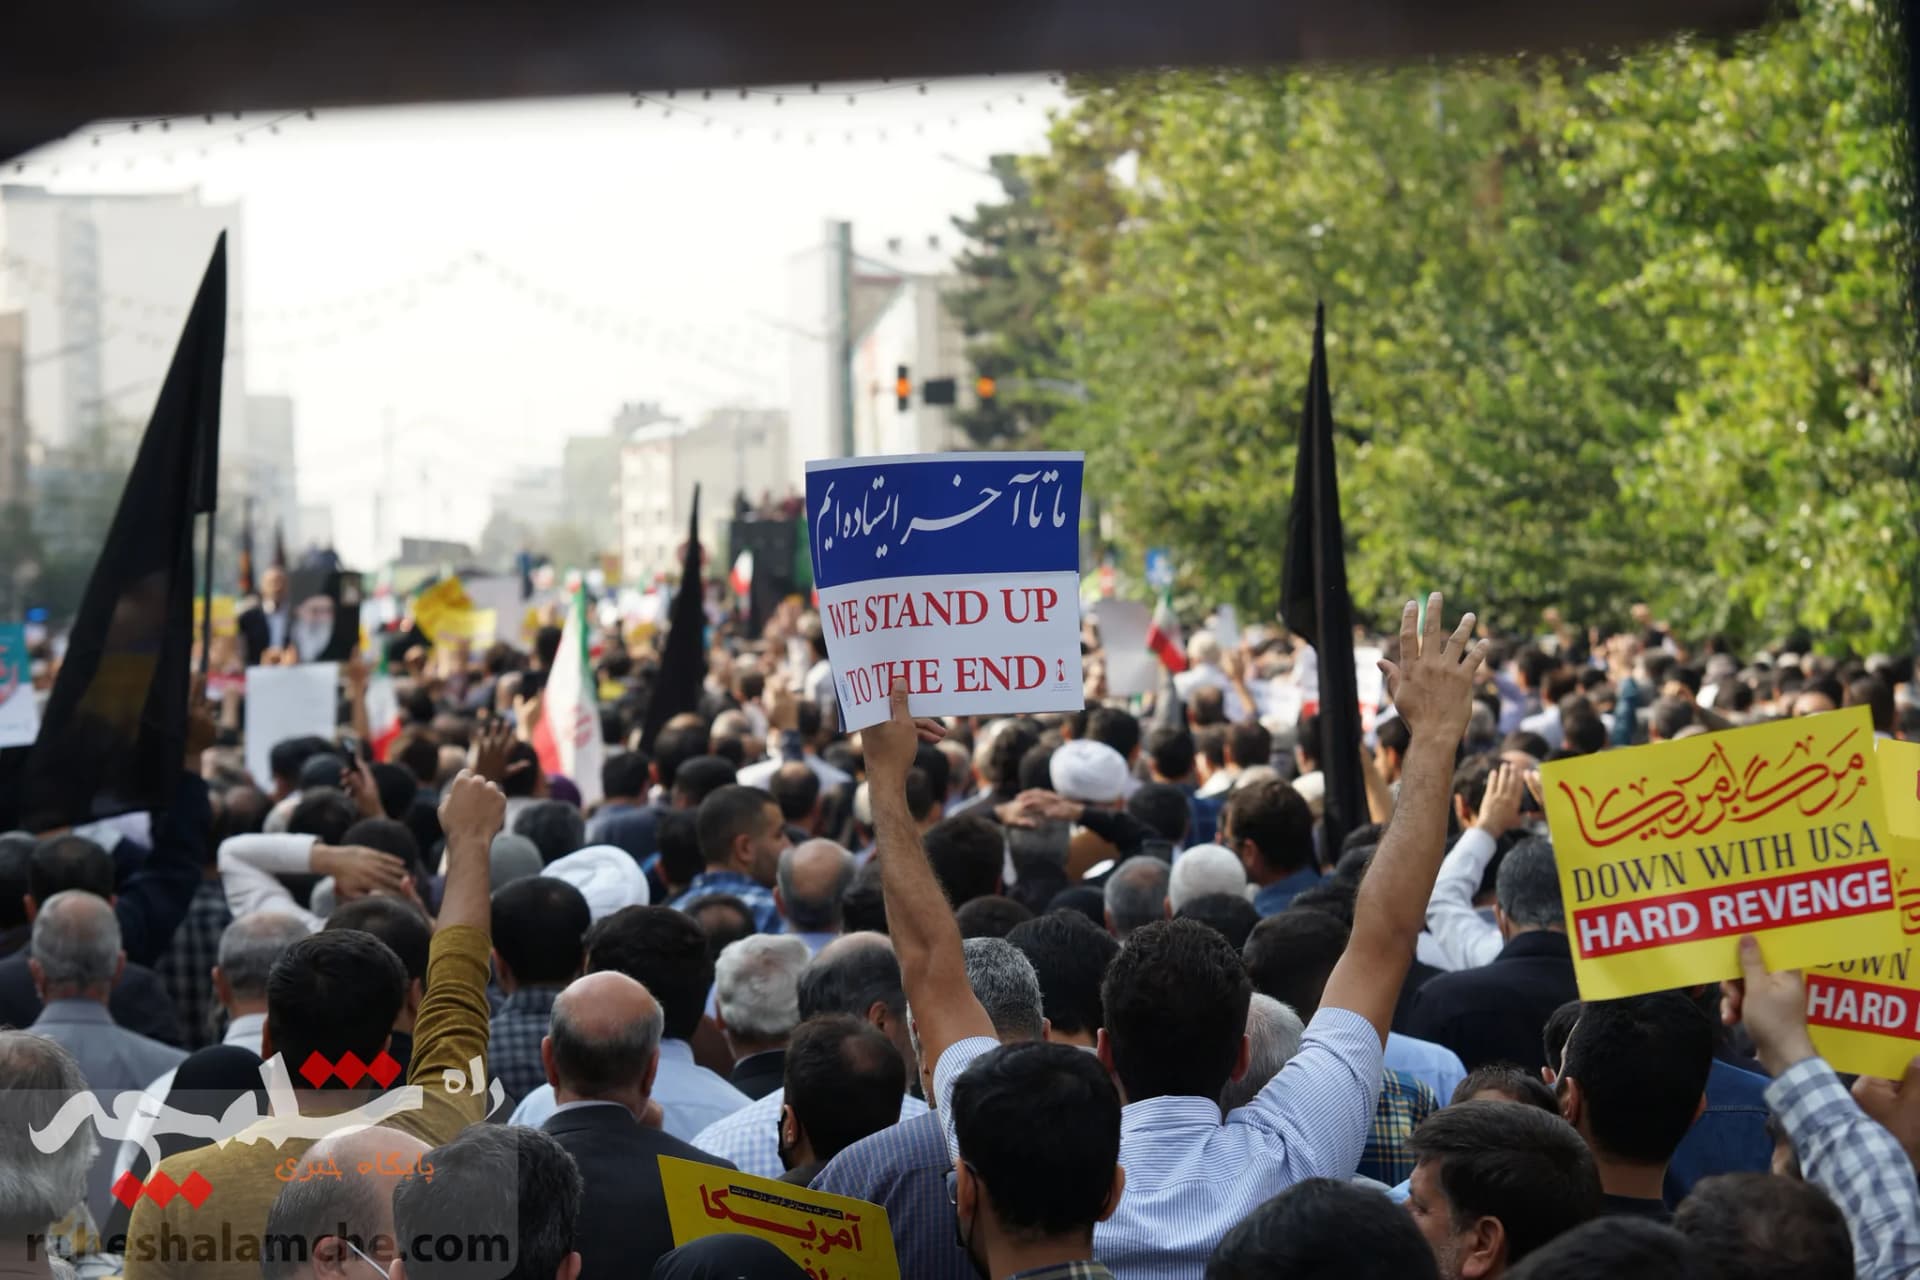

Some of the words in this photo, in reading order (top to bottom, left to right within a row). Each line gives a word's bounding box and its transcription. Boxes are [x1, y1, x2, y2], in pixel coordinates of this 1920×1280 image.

[900, 470, 1042, 546] آخر
[828, 599, 861, 641] WE
[864, 589, 990, 633] STAND
[1000, 587, 1059, 624] UP
[846, 666, 873, 706] TO
[871, 658, 944, 698] THE
[953, 655, 1047, 692] END
[1572, 851, 1687, 903] DOWN
[1695, 832, 1797, 880] WITH
[1807, 819, 1882, 863] USA
[1578, 900, 1700, 951] HARD
[1708, 867, 1892, 931] REVENGE
[1815, 947, 1912, 981] WN
[1806, 983, 1908, 1029] HARD
[700, 1184, 863, 1255] آمریکا
